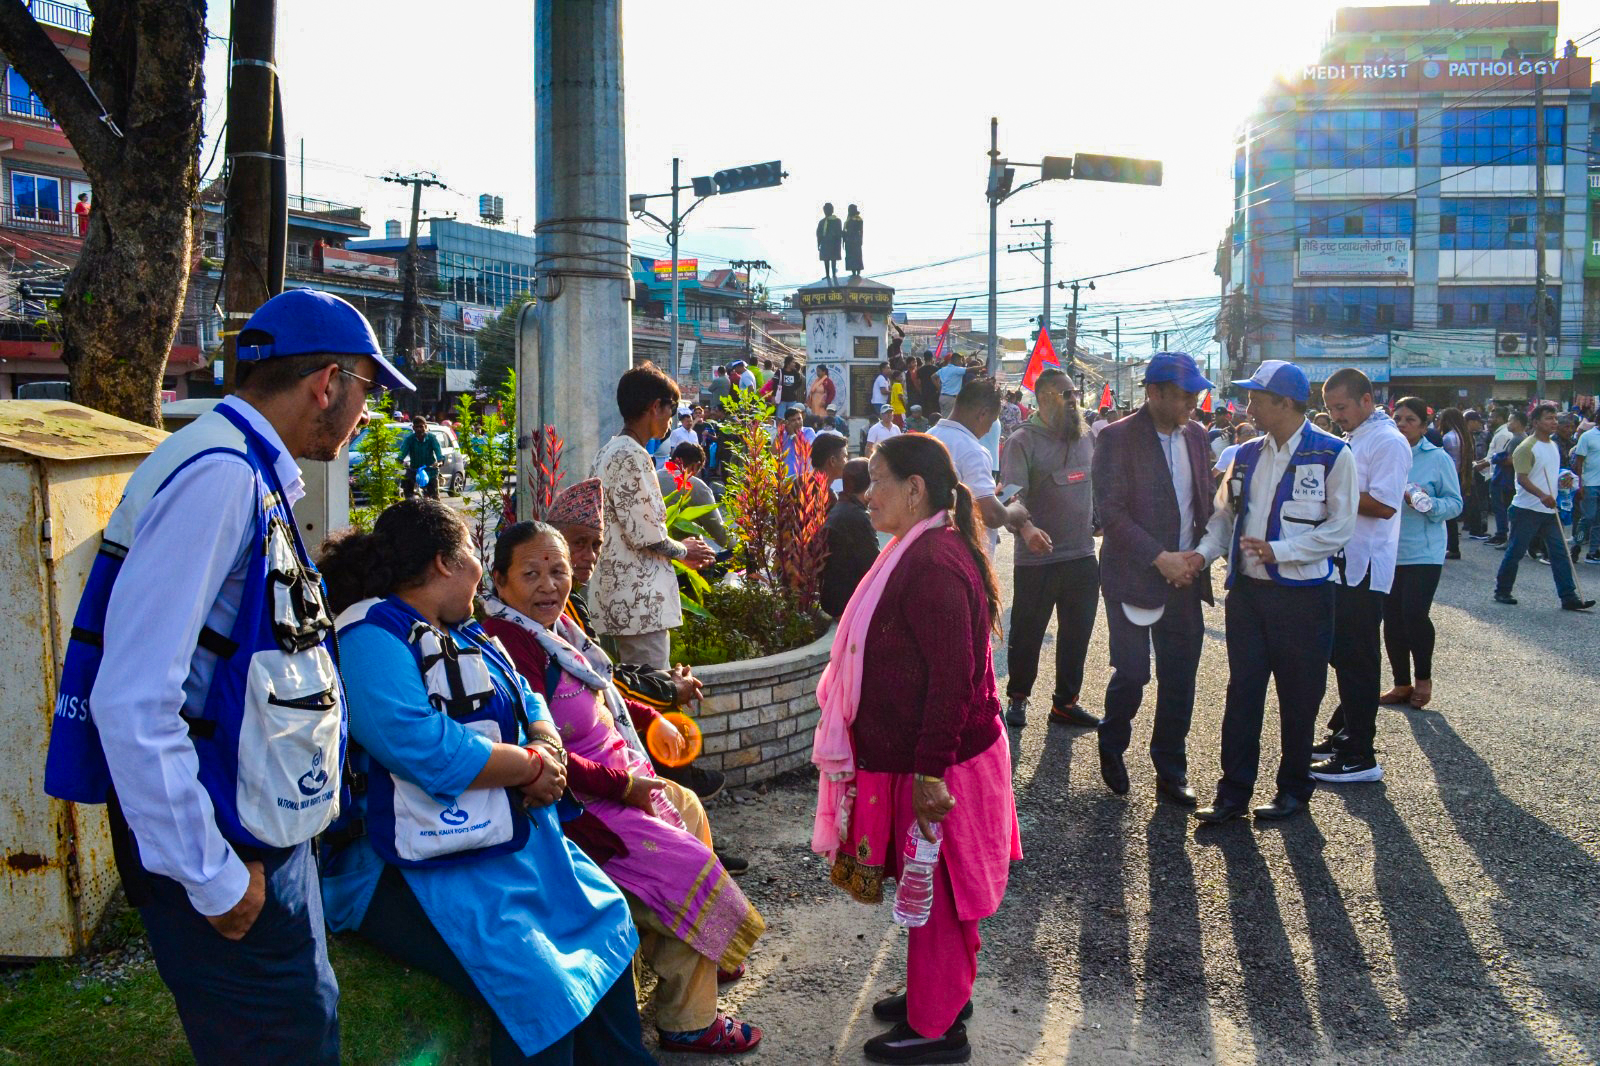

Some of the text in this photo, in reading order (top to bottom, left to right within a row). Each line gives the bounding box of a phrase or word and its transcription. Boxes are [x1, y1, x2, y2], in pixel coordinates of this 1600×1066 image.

[1303, 61, 1560, 80] MEDI TRUST PATHOLOGY
